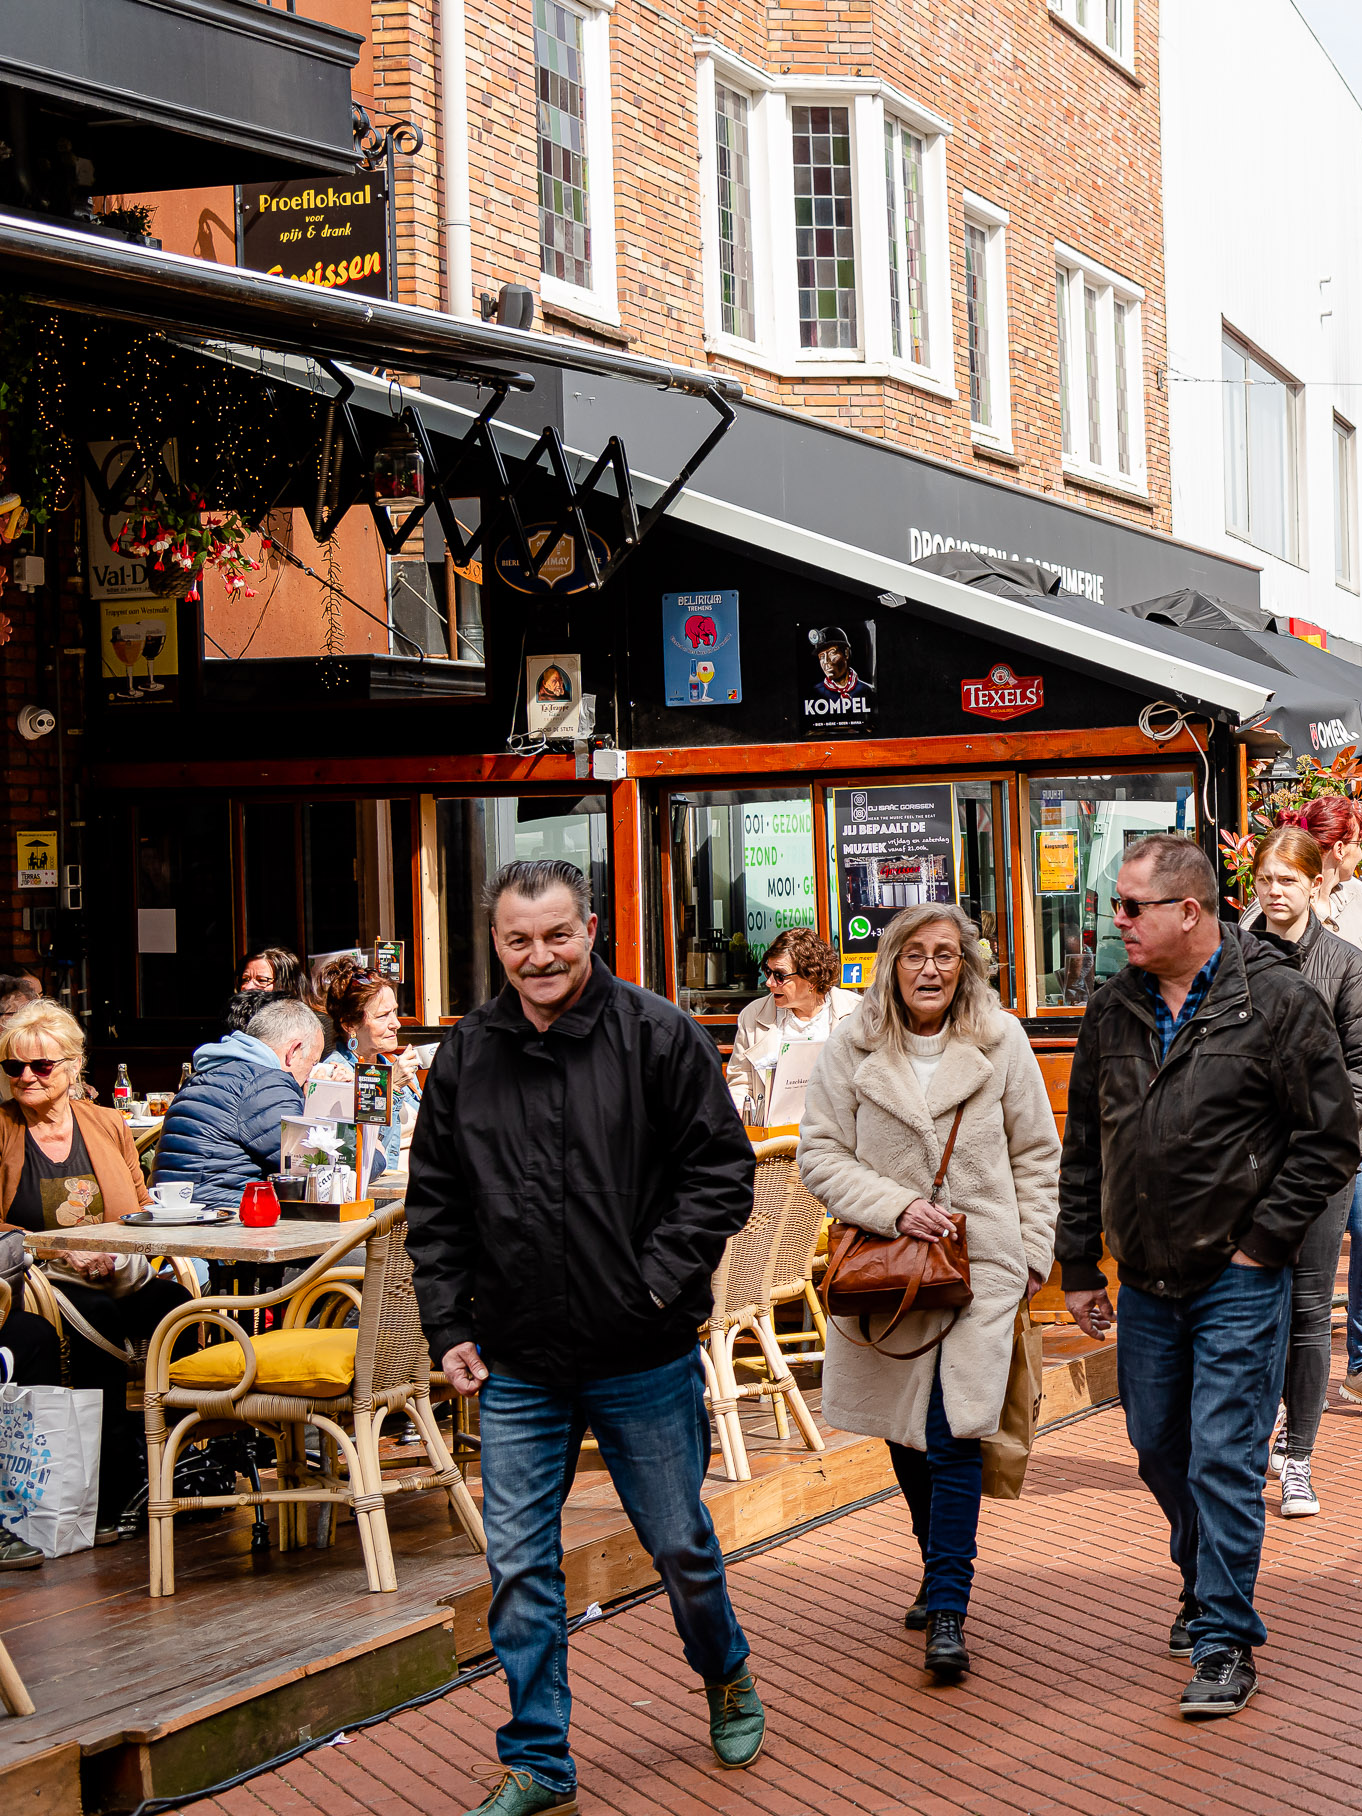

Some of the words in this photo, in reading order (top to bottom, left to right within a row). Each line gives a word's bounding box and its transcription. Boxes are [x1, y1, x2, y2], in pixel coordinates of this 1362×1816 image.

[259, 184, 371, 213] Proeflokaal
[305, 214, 325, 223] voor
[279, 228, 302, 243] spijs
[307, 225, 316, 239] &
[321, 222, 352, 238] drank
[92, 563, 149, 587] Val-D
[804, 697, 871, 715] KOMPEL
[963, 685, 1038, 708] TEXELS
[900, 802, 935, 811] GORISSEN
[745, 814, 764, 834] OOI
[772, 814, 811, 834] GEZOND
[842, 824, 857, 836] JIJ
[859, 822, 909, 835] BEPAALT
[910, 821, 926, 833] DE
[843, 842, 887, 854] MUZIEK
[887, 837, 911, 845] vrijdag
[922, 836, 950, 844] zaterdag
[745, 846, 778, 867] EZOND
[767, 877, 795, 898] MOOI
[747, 910, 766, 931] OOI
[775, 906, 815, 929] GEZOND
[134, 1243, 152, 1253] 108
